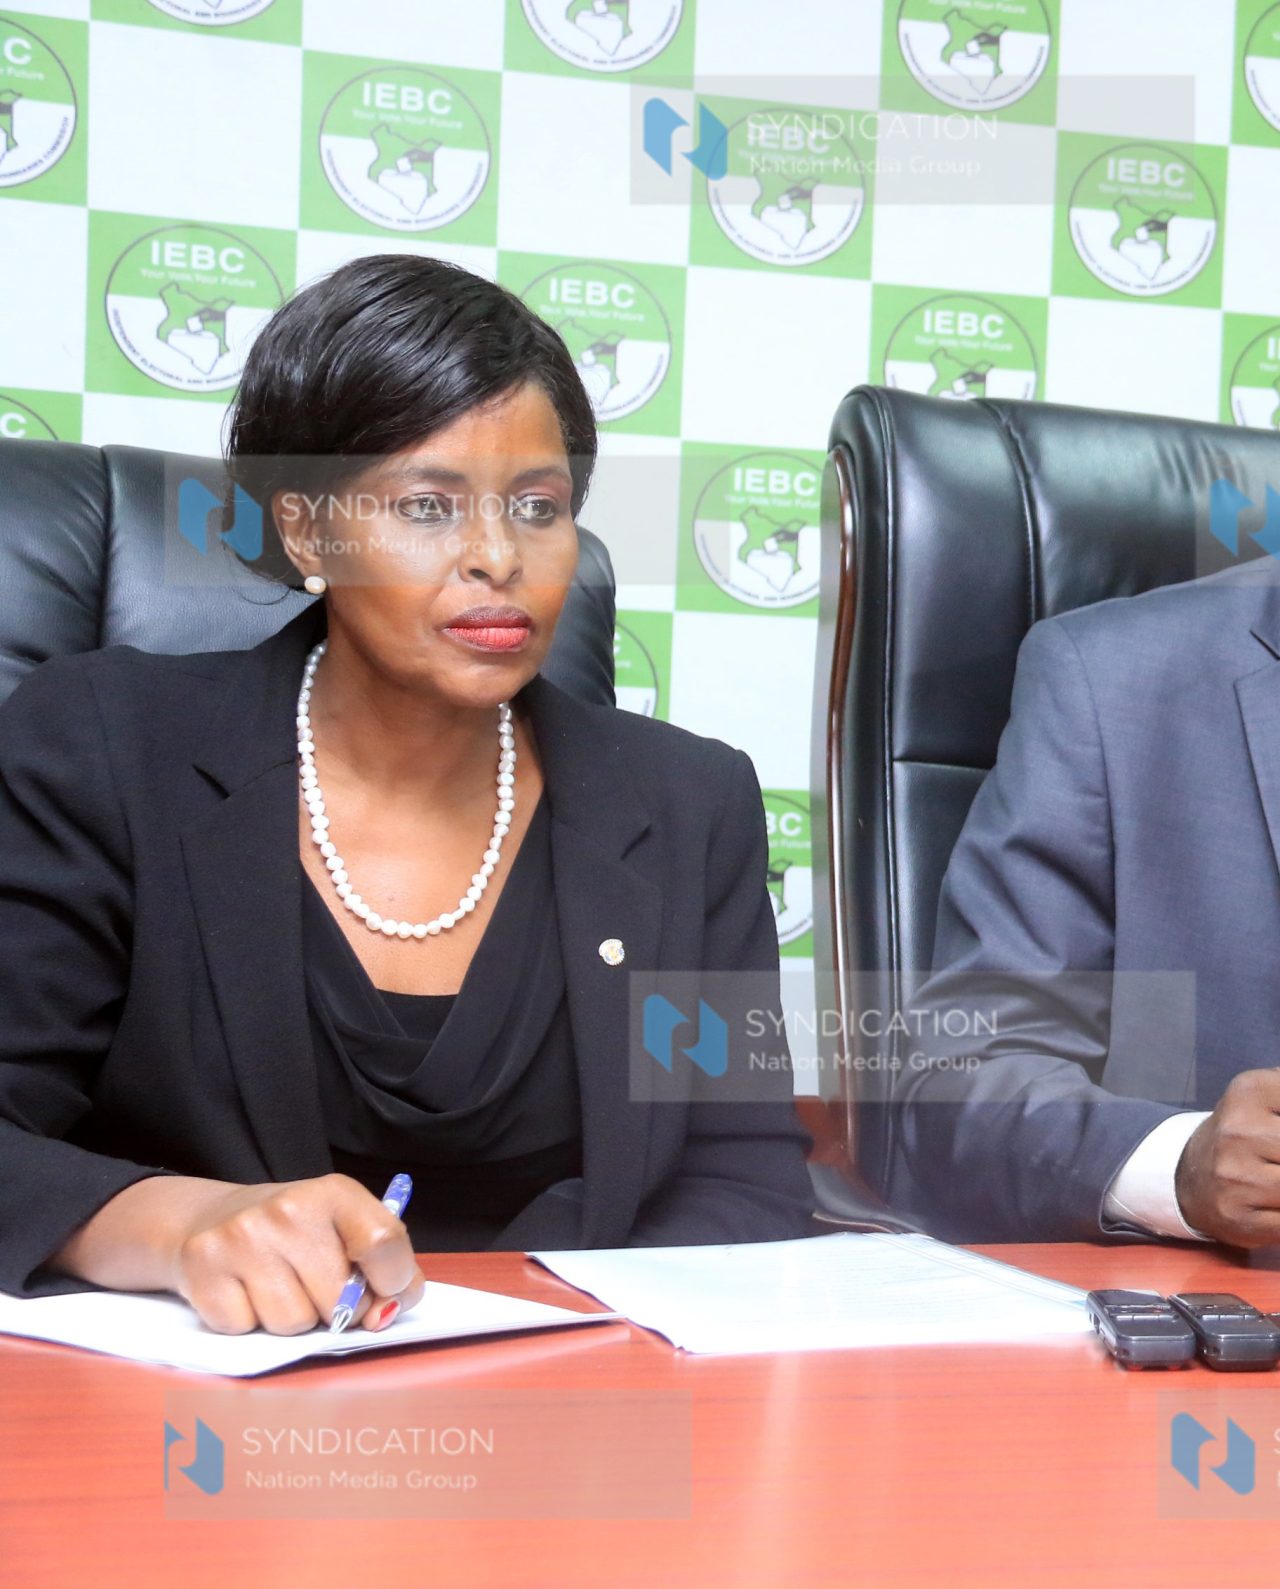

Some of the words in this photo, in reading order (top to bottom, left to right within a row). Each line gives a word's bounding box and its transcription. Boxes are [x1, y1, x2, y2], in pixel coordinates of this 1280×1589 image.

[362, 81, 452, 115] IEBC
[1107, 158, 1185, 187] IEBC
[151, 239, 245, 274] IEBC
[550, 277, 635, 309] IEBC
[923, 309, 1004, 340] IEBC
[734, 466, 817, 497] IEBC
[765, 811, 803, 837] BC
